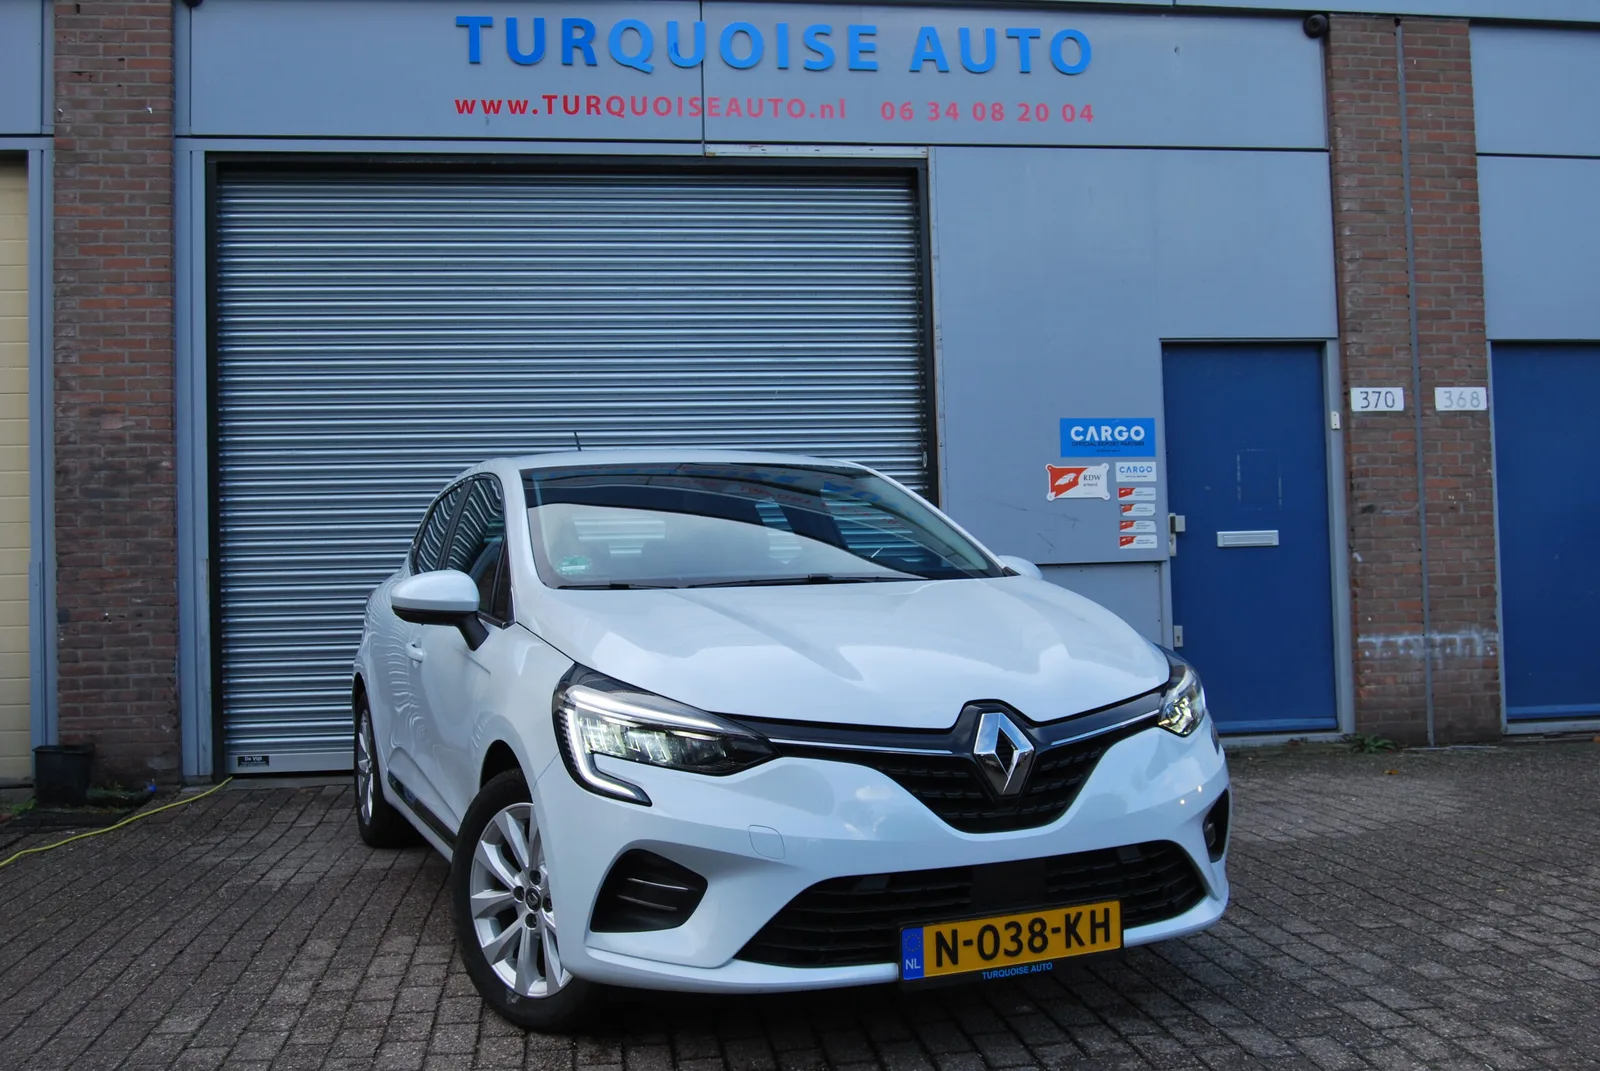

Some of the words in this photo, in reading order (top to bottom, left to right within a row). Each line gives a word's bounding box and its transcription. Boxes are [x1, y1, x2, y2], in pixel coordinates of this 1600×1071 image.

[456, 16, 879, 74] TURQUOISE
[909, 26, 1092, 75] AUTO
[455, 94, 846, 119] www.TURQUOISEAUTO.nl
[881, 101, 914, 121] 06
[927, 102, 959, 121] 34
[972, 102, 1004, 122] 08
[1018, 103, 1049, 122] 20
[1062, 104, 1094, 122] 04
[1360, 390, 1395, 409] 370
[1444, 390, 1481, 409] 368
[1070, 425, 1145, 442] CARGO
[1119, 466, 1153, 474] CARGO
[935, 908, 1110, 967] N-038-KH
[905, 958, 921, 970] NL
[981, 966, 1029, 980] TURQUOISE
[1030, 962, 1053, 974] AUTO
